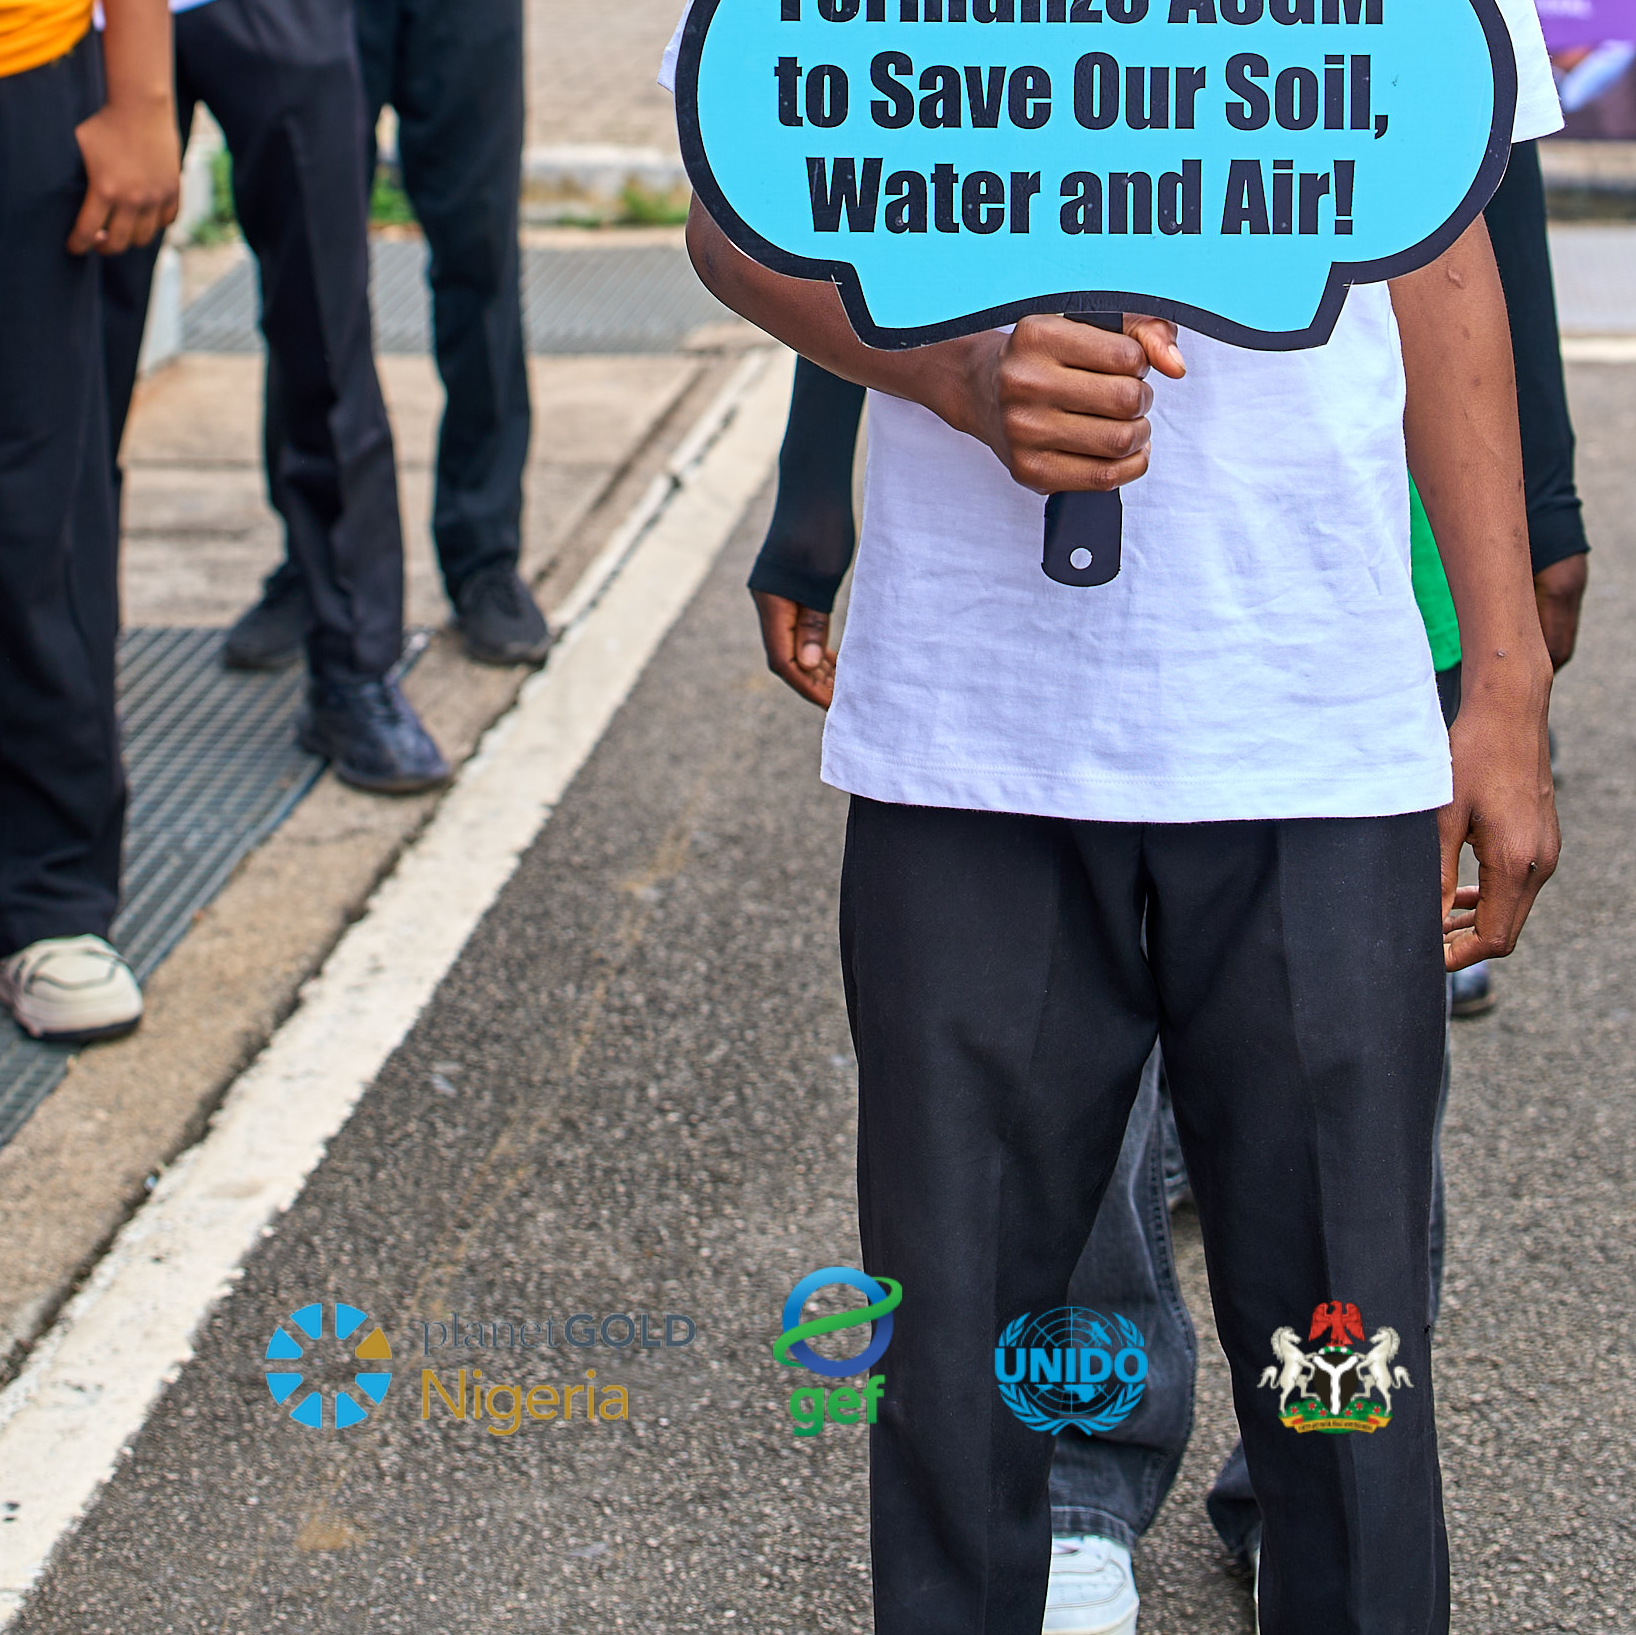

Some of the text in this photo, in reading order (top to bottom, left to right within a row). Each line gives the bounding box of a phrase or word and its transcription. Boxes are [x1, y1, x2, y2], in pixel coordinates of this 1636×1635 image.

[774, 51, 1389, 141] to Save Our Soil,
[805, 156, 1356, 236] Water and Air!
